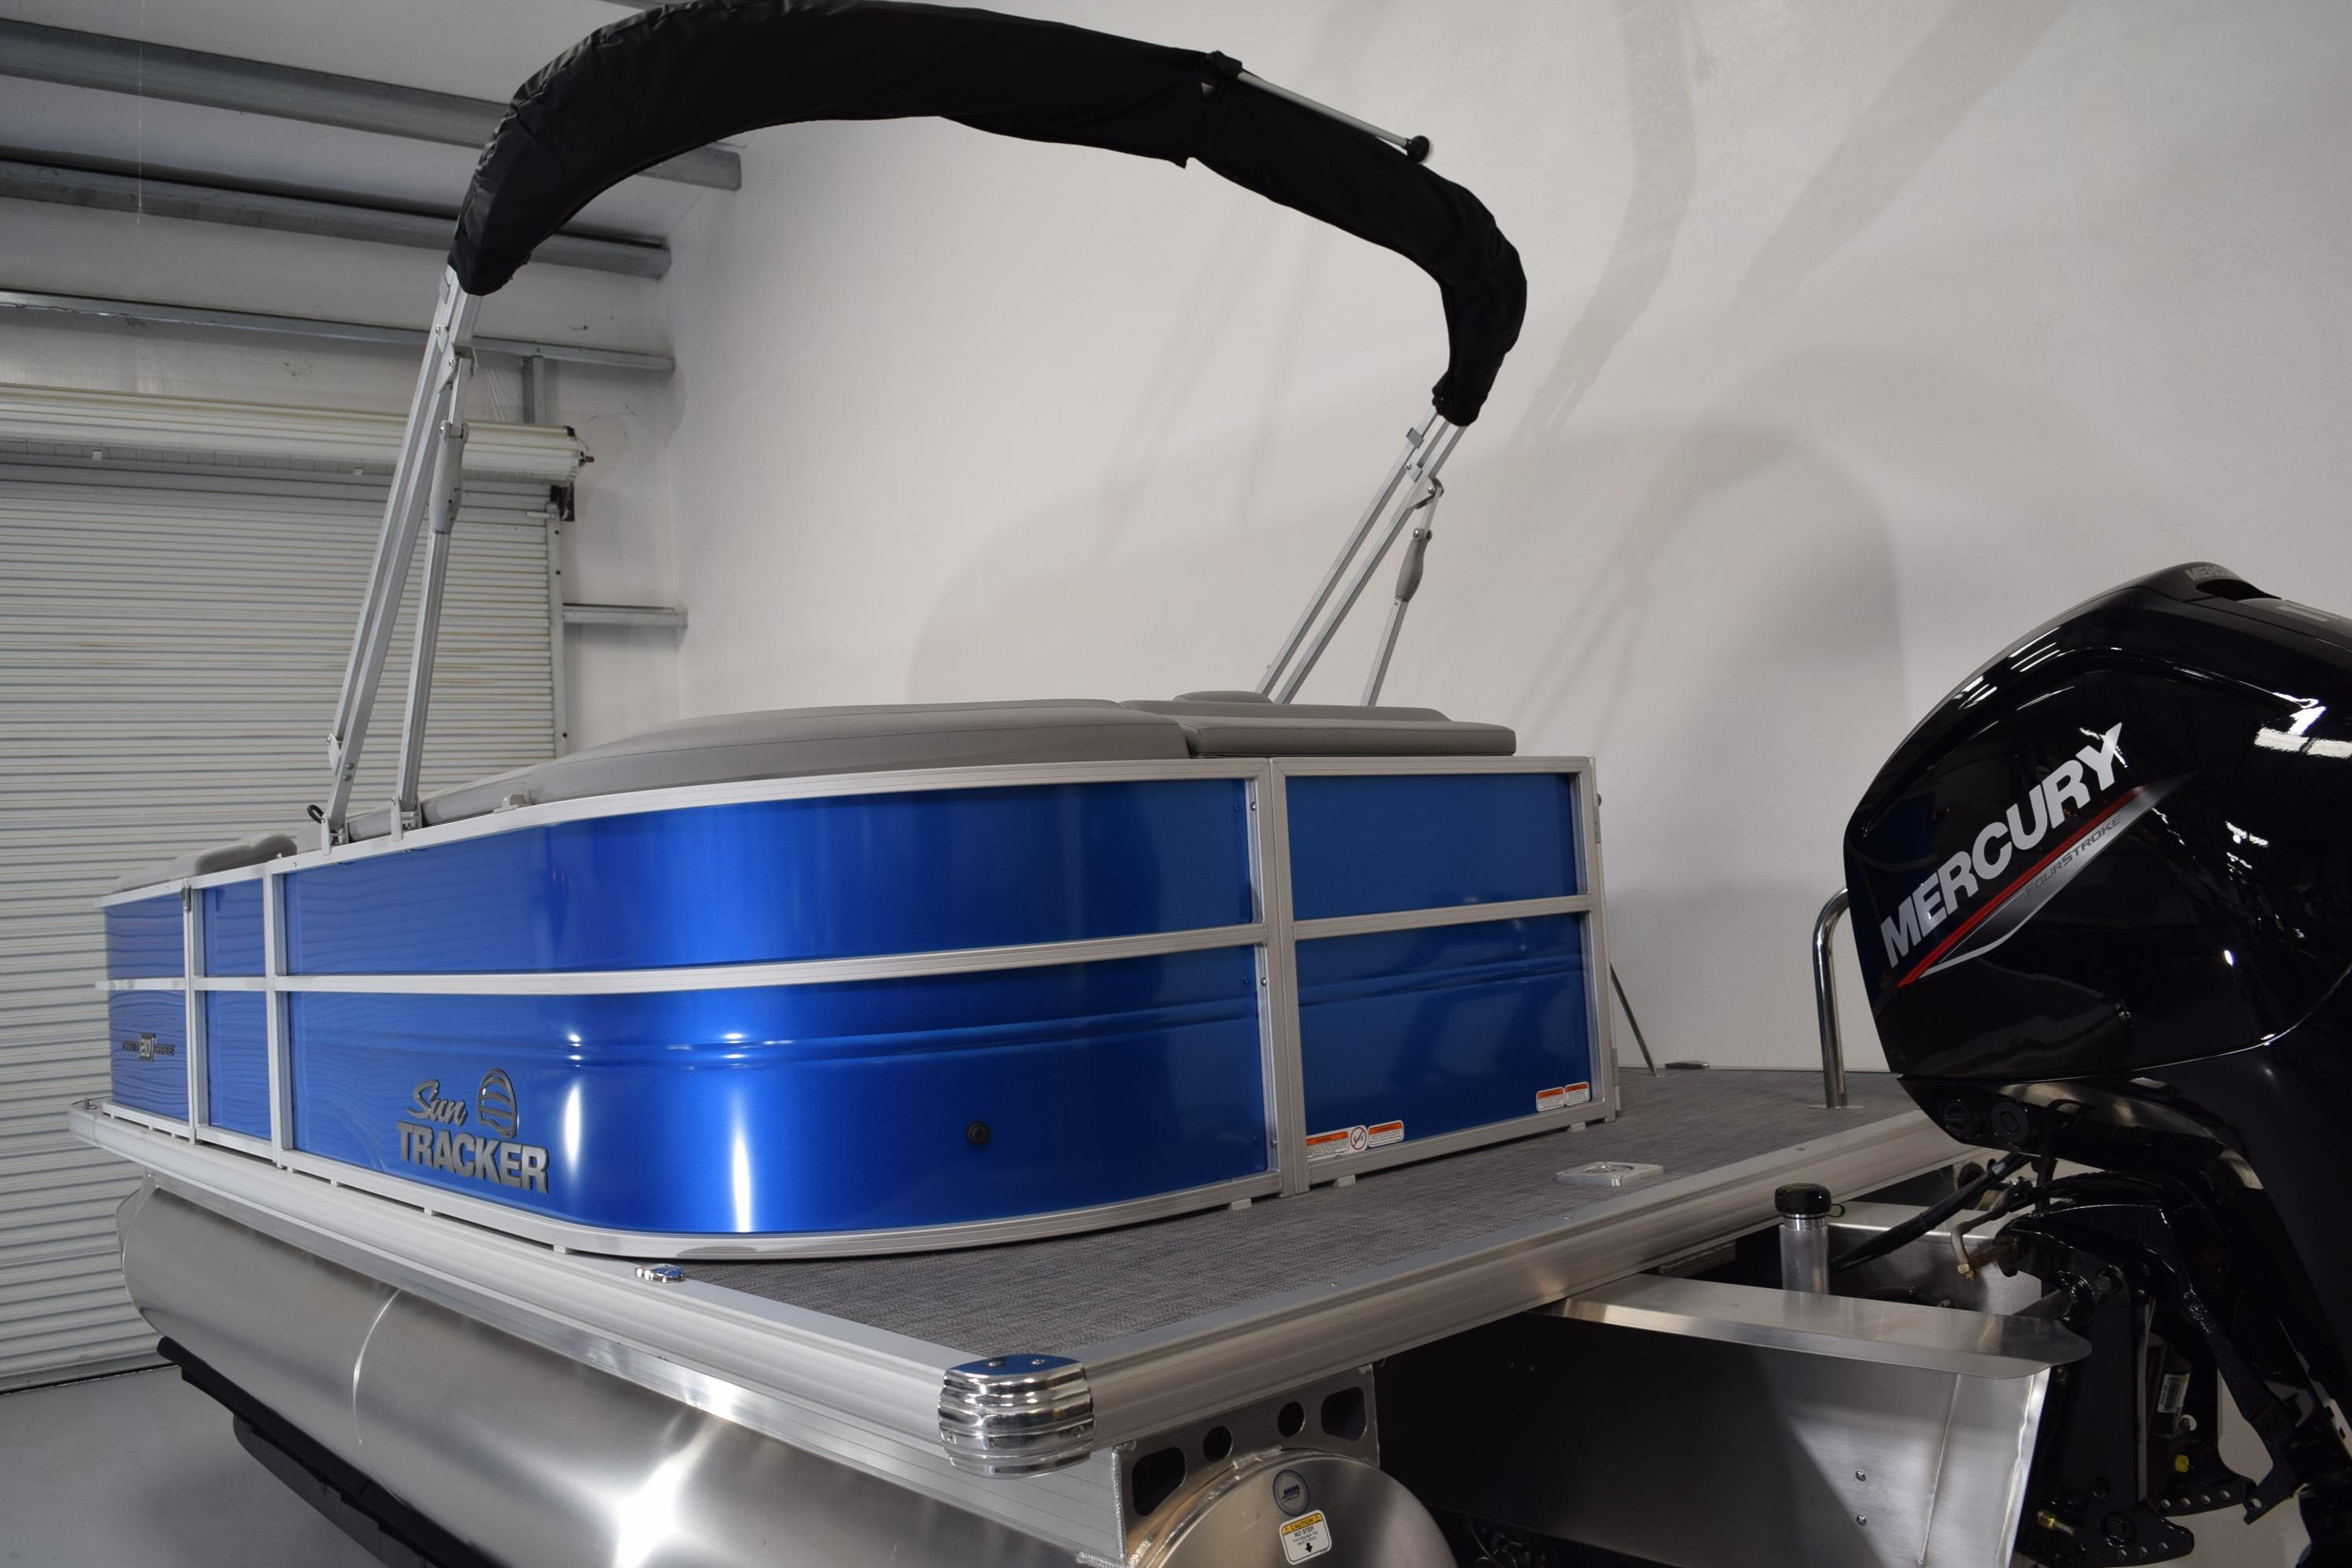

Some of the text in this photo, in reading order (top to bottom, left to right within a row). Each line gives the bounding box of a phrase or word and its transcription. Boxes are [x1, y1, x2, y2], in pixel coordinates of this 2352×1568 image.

[1880, 722, 2122, 968] MERCURY
[2023, 814, 2122, 894] FOURSTROKE
[407, 1079, 468, 1127] Sun
[397, 1119, 549, 1195] TRACKER
[1290, 1517, 1314, 1531] CAUTION
